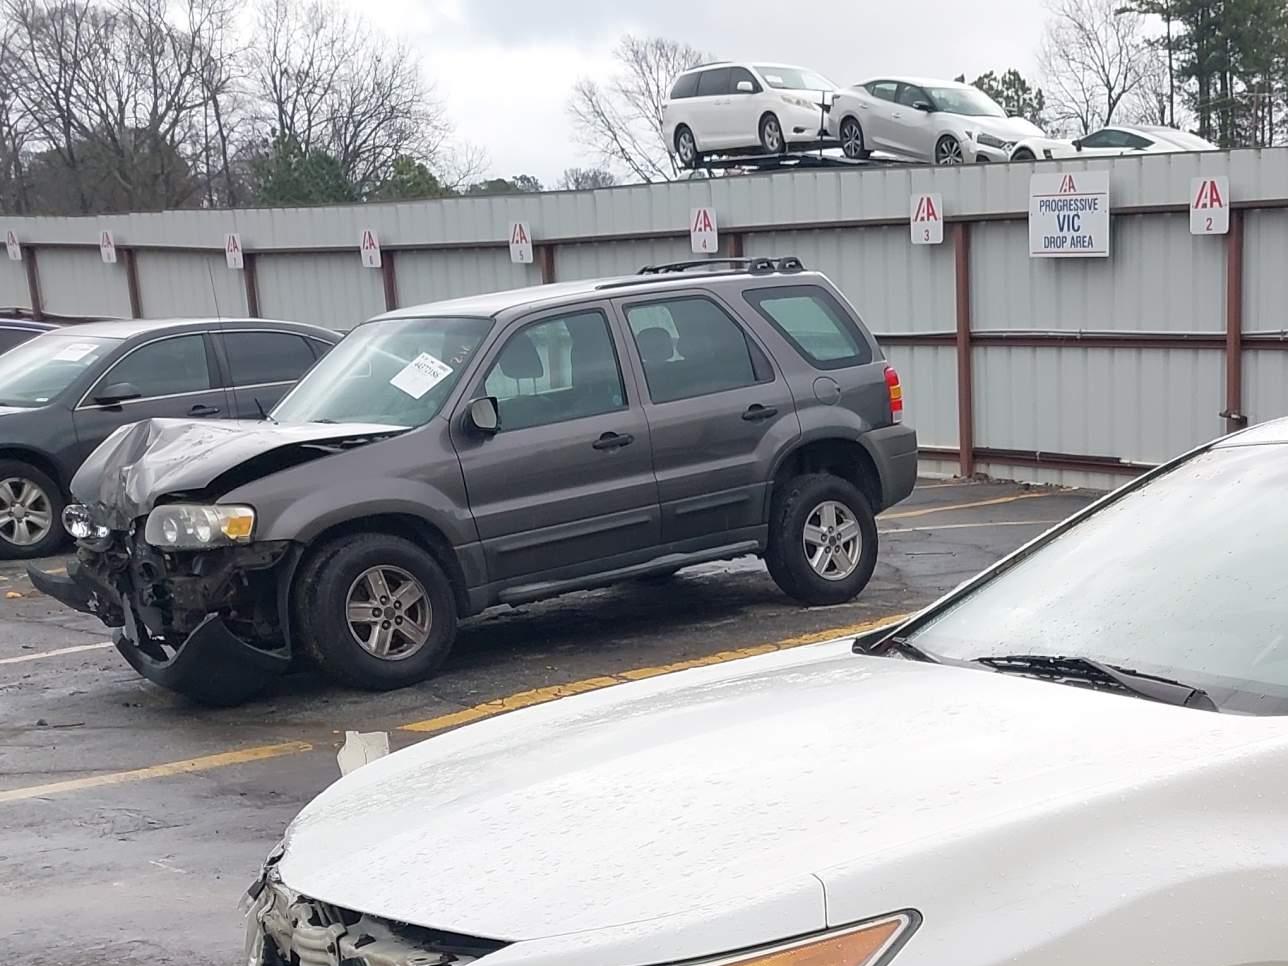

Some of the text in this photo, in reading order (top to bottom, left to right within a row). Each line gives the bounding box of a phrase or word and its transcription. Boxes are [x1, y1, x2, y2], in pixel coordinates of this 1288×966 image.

[1039, 198, 1099, 213] PROGRESSIVE
[1057, 213, 1081, 233] VIC
[1206, 217, 1213, 231] 2
[924, 229, 930, 242] 3
[1043, 234, 1094, 249] DROP AREA
